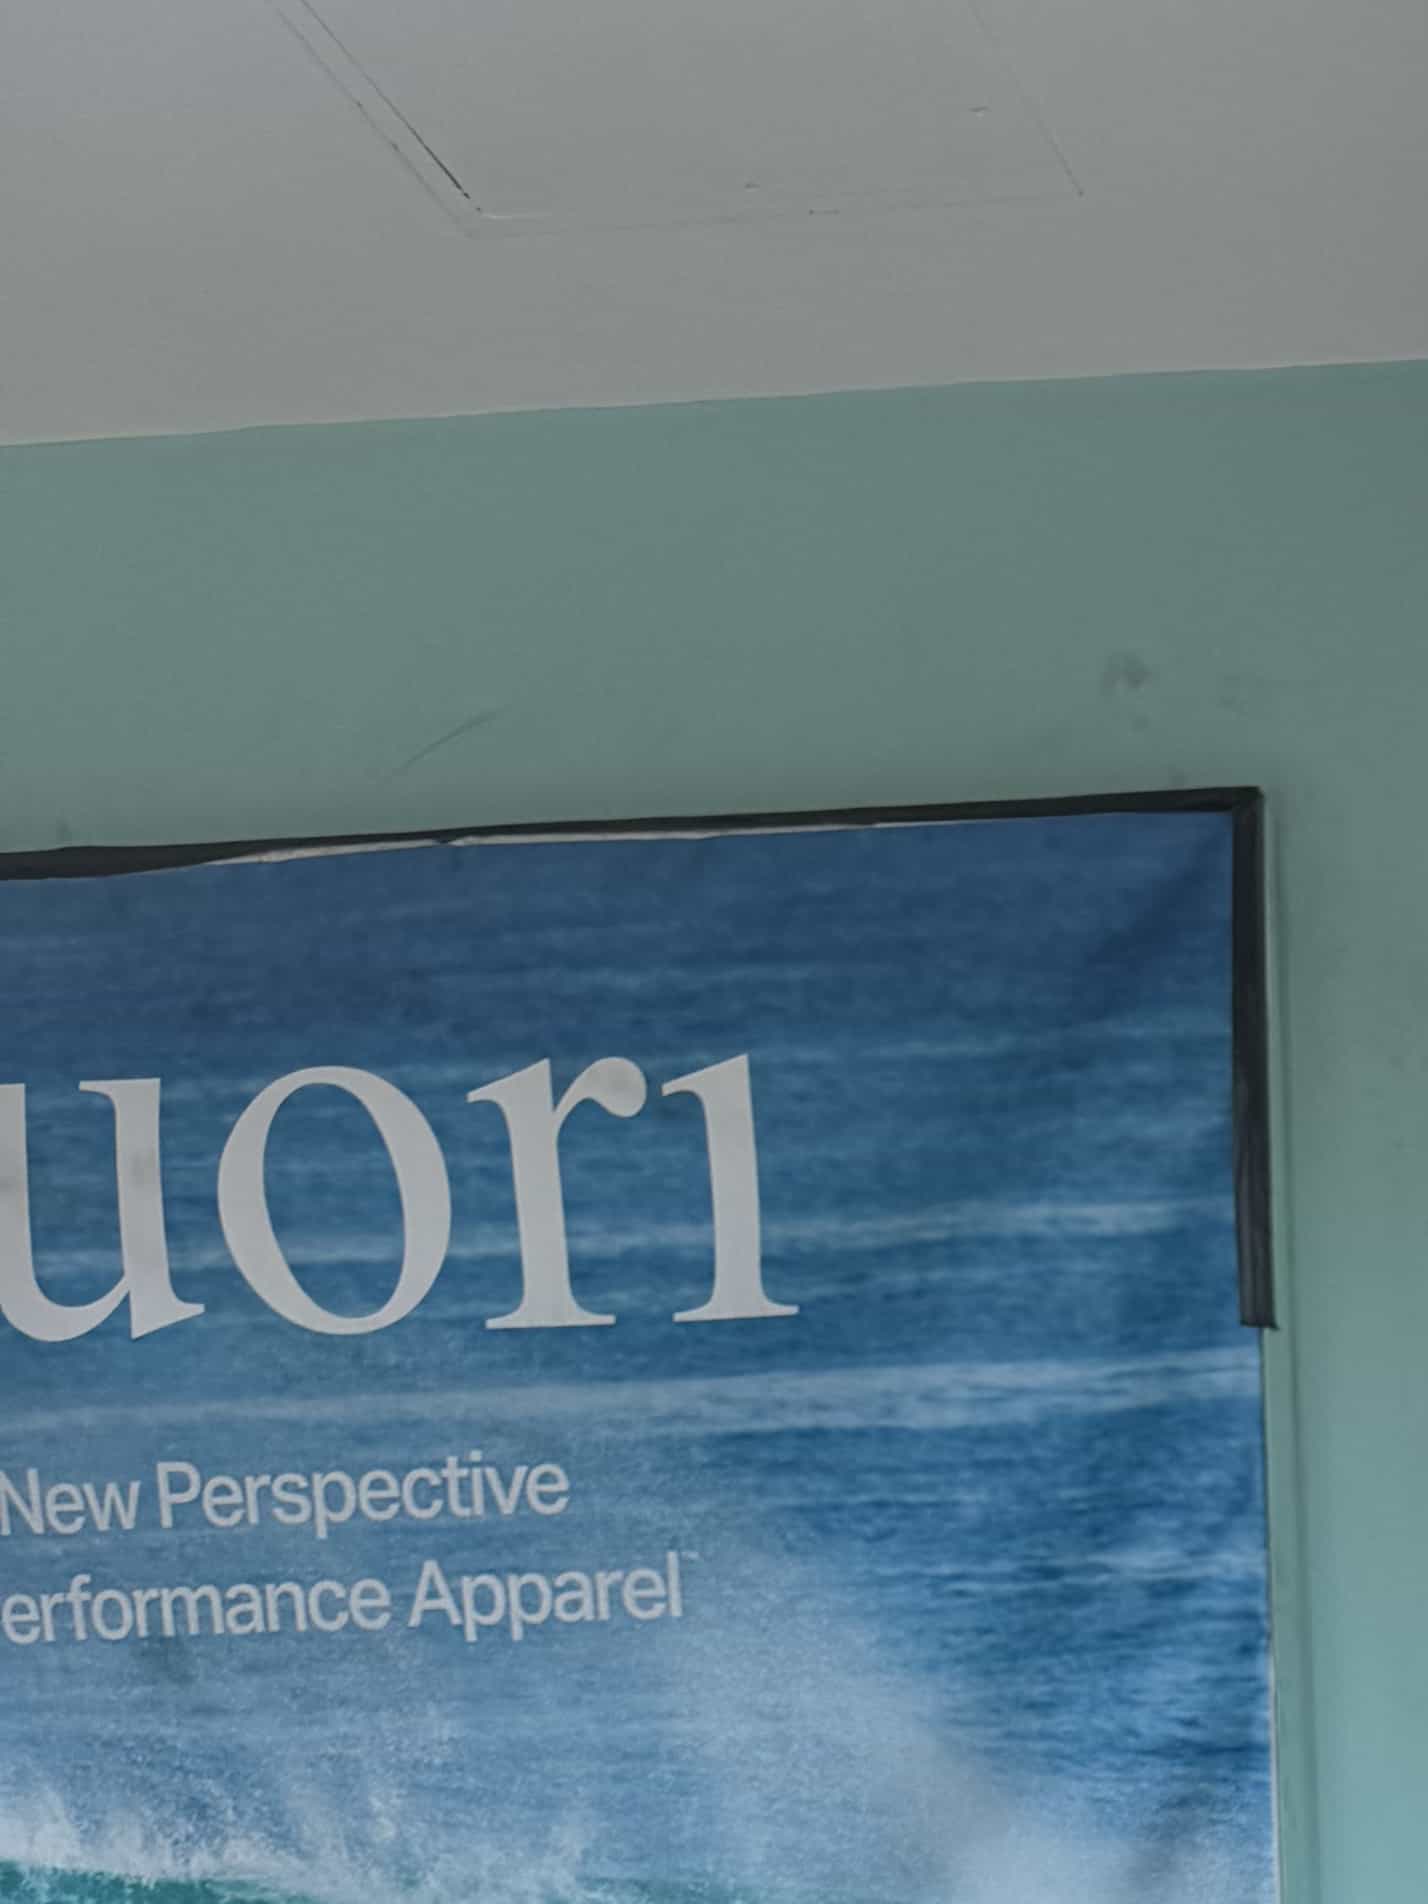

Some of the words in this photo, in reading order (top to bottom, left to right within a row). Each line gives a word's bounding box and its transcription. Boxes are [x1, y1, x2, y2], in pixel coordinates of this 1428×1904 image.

[0, 1467, 141, 1536] New
[156, 1449, 571, 1540] Perspective
[0, 1573, 391, 1645] erformance
